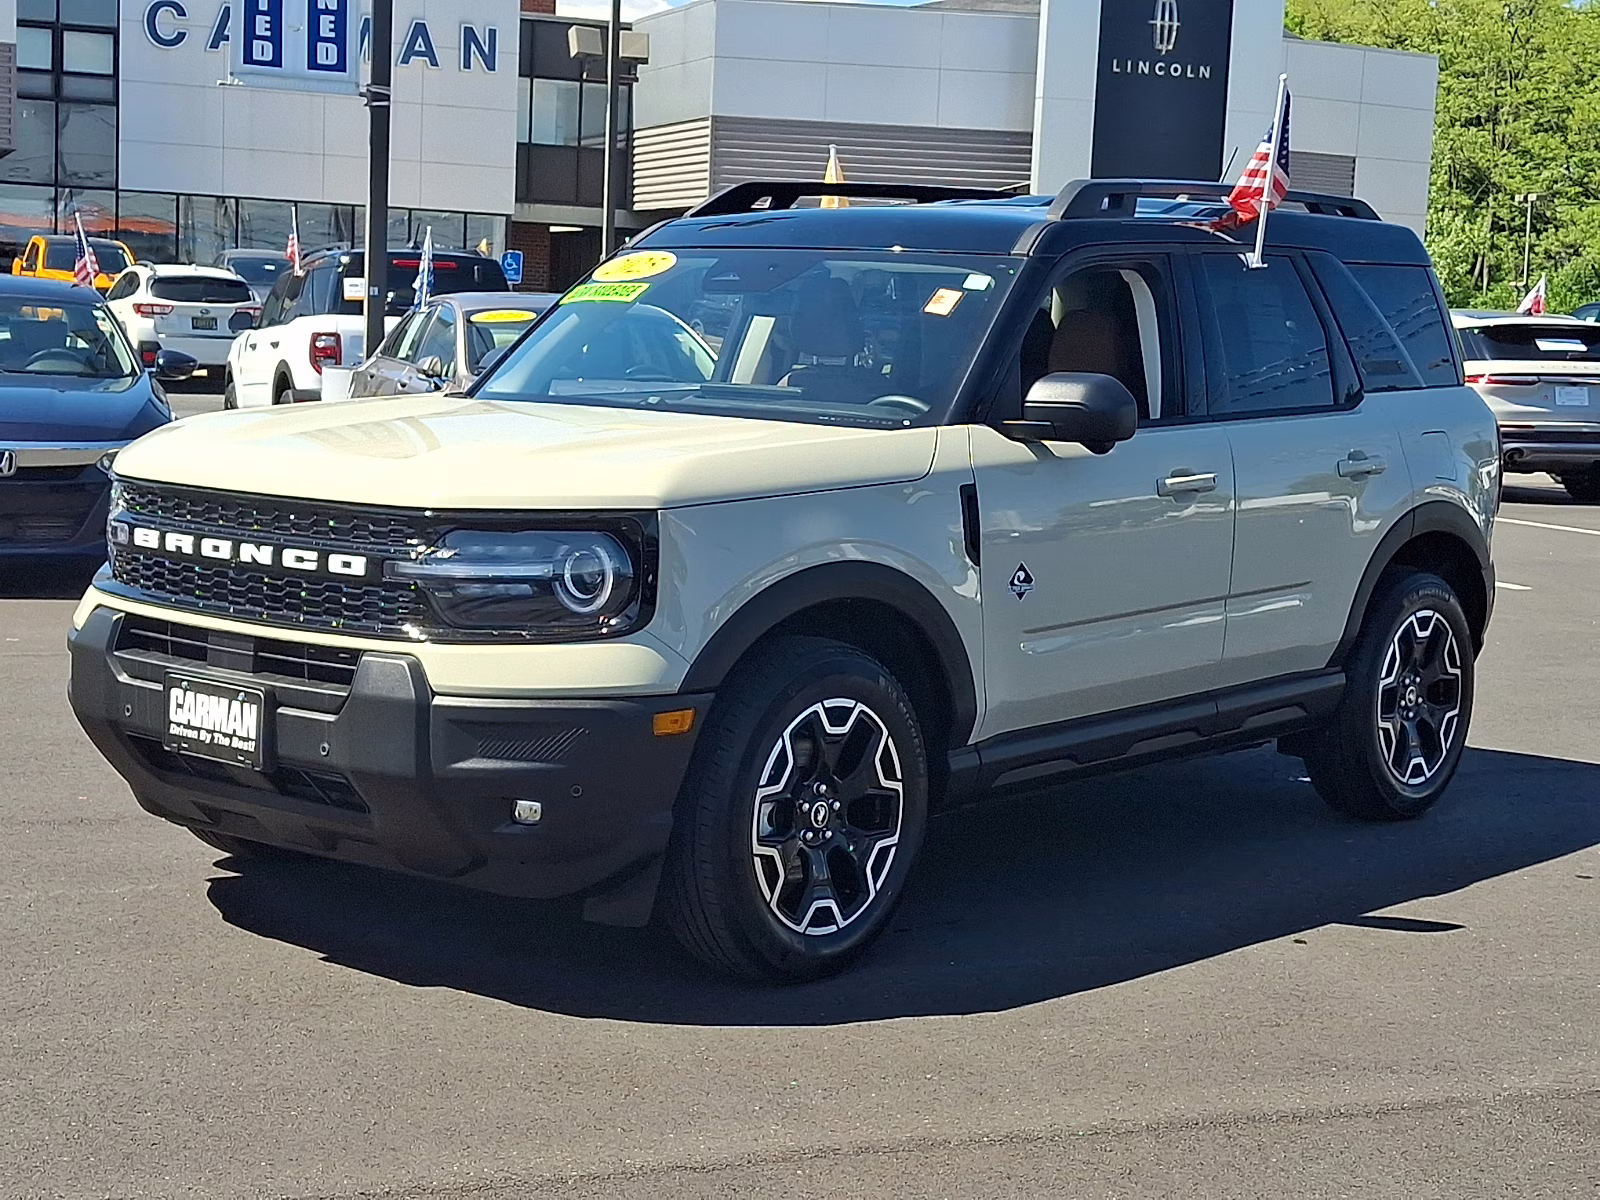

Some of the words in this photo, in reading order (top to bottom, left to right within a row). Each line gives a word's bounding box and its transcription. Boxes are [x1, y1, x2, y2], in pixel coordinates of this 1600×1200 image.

[144, 0, 498, 73] CAAN
[1112, 58, 1211, 79] LINCOLN
[133, 527, 368, 577] BRONCO
[169, 687, 258, 740] CARMAN
[169, 722, 199, 740] Driven
[199, 729, 212, 744] By
[212, 732, 231, 747] The
[231, 735, 256, 752] Best!
